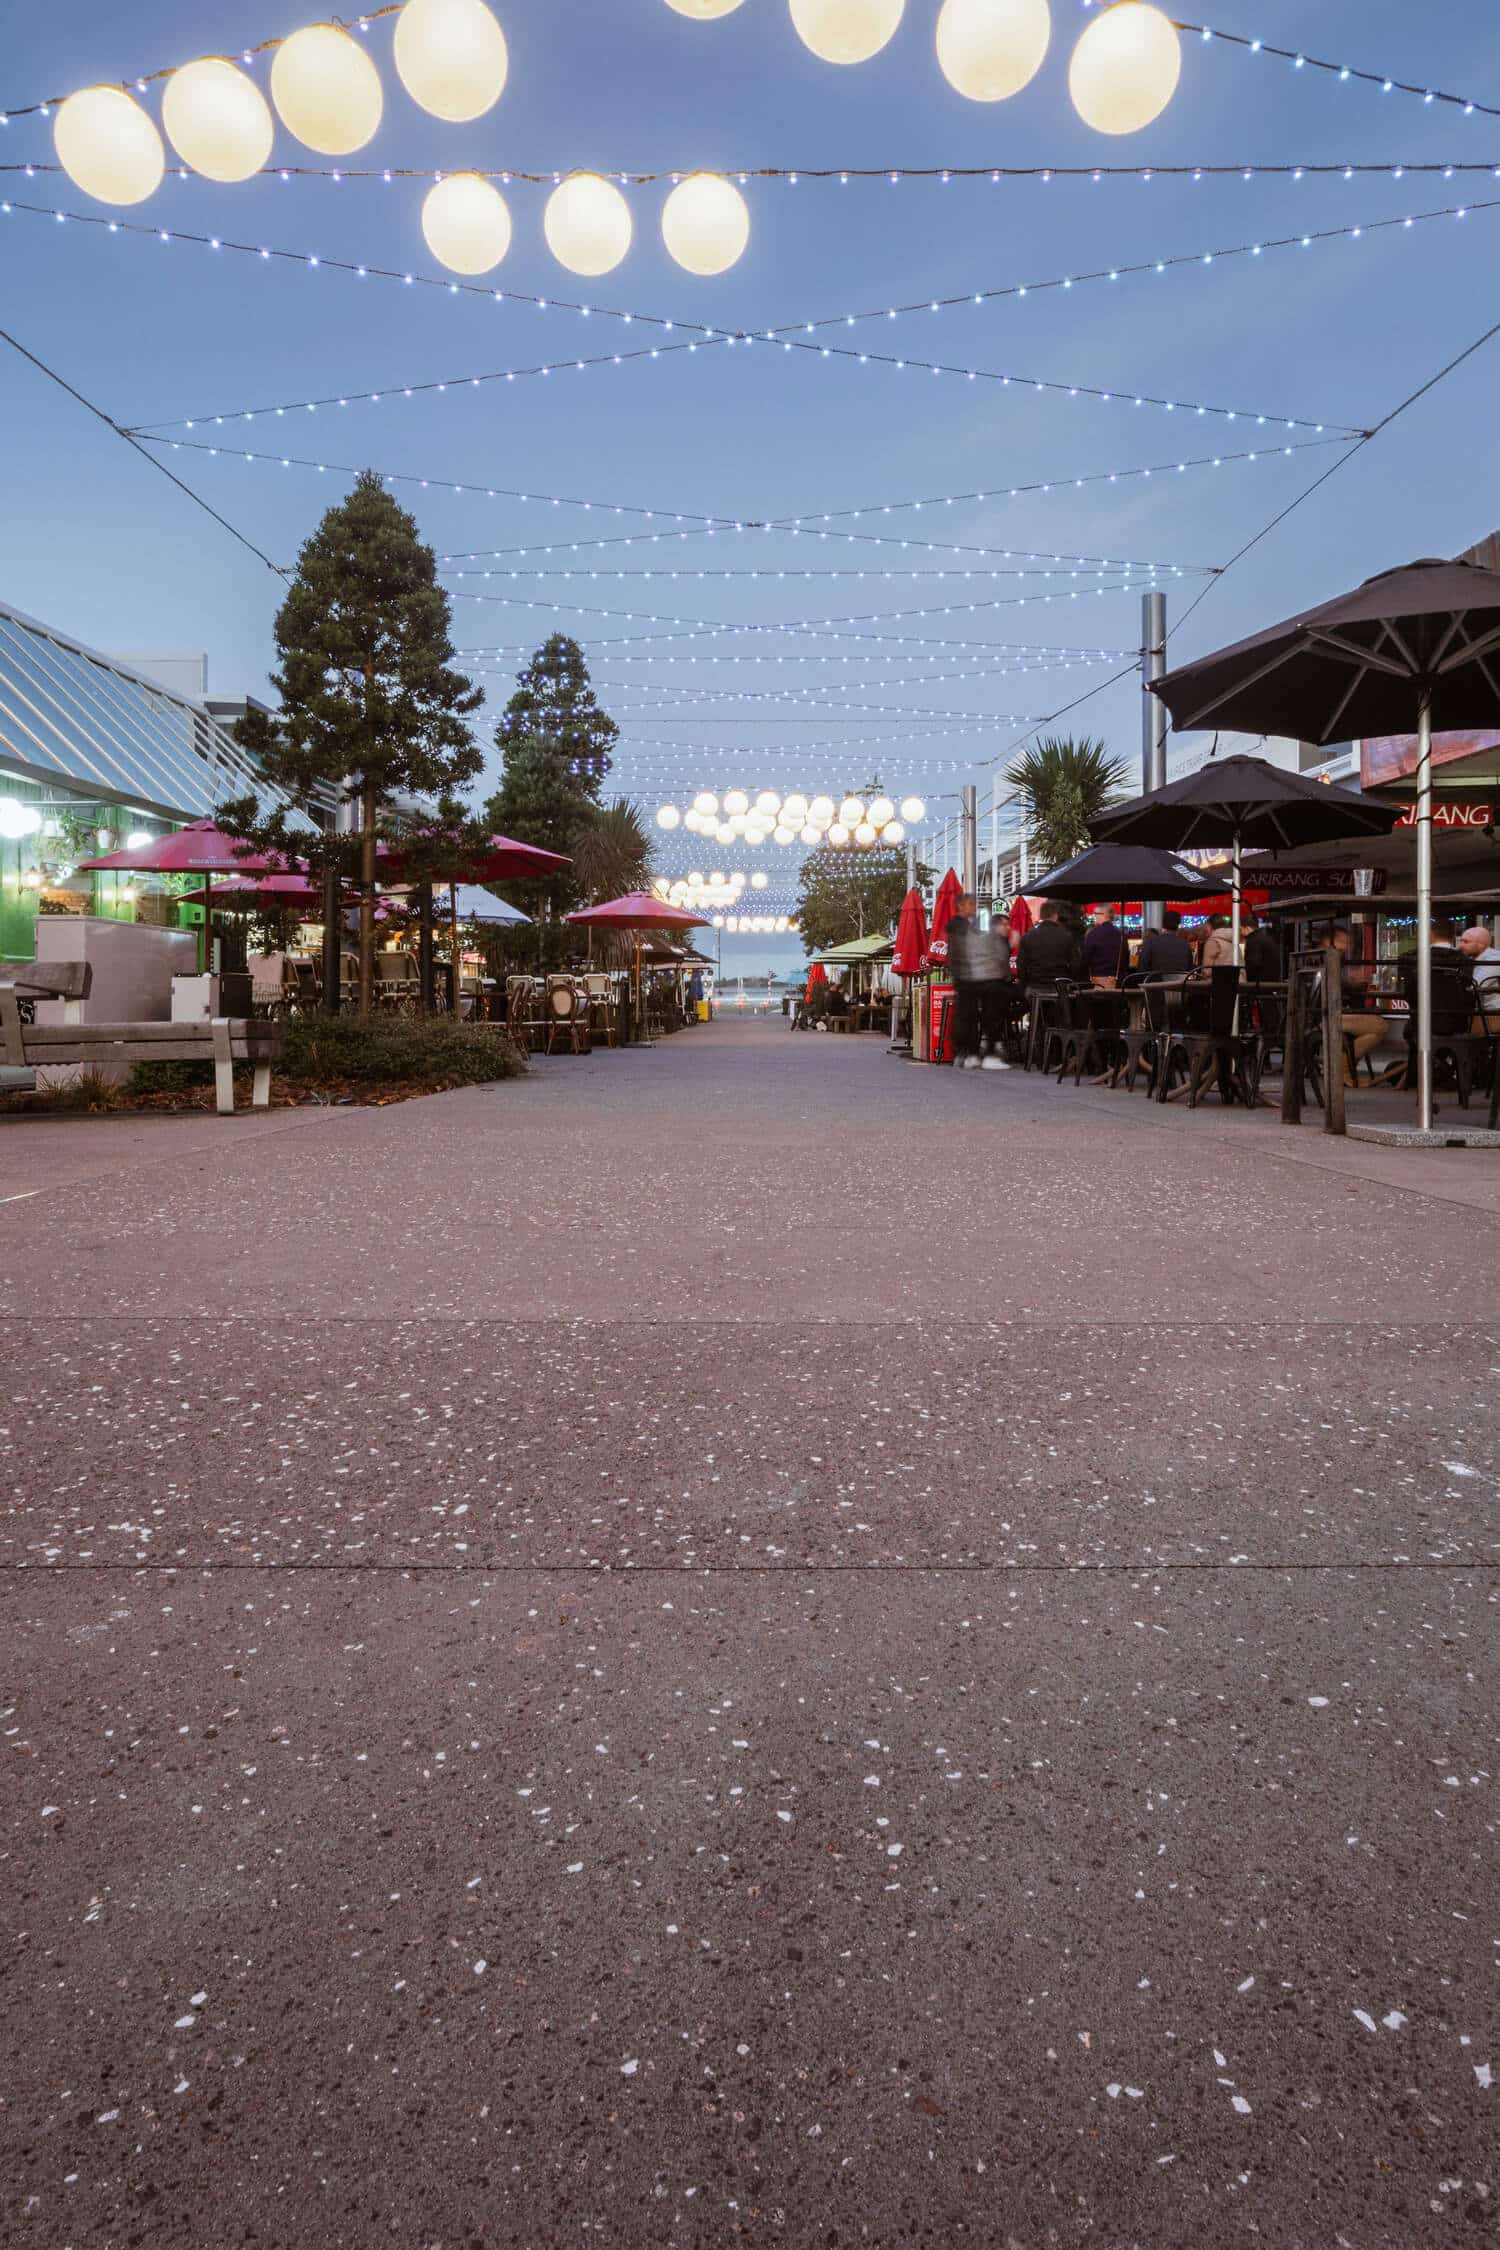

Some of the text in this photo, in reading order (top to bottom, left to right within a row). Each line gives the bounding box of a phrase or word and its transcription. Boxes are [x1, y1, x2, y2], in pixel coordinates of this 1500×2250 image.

[1395, 805, 1489, 825] RIANG
[1245, 872, 1384, 886] ARIRANG SUI
